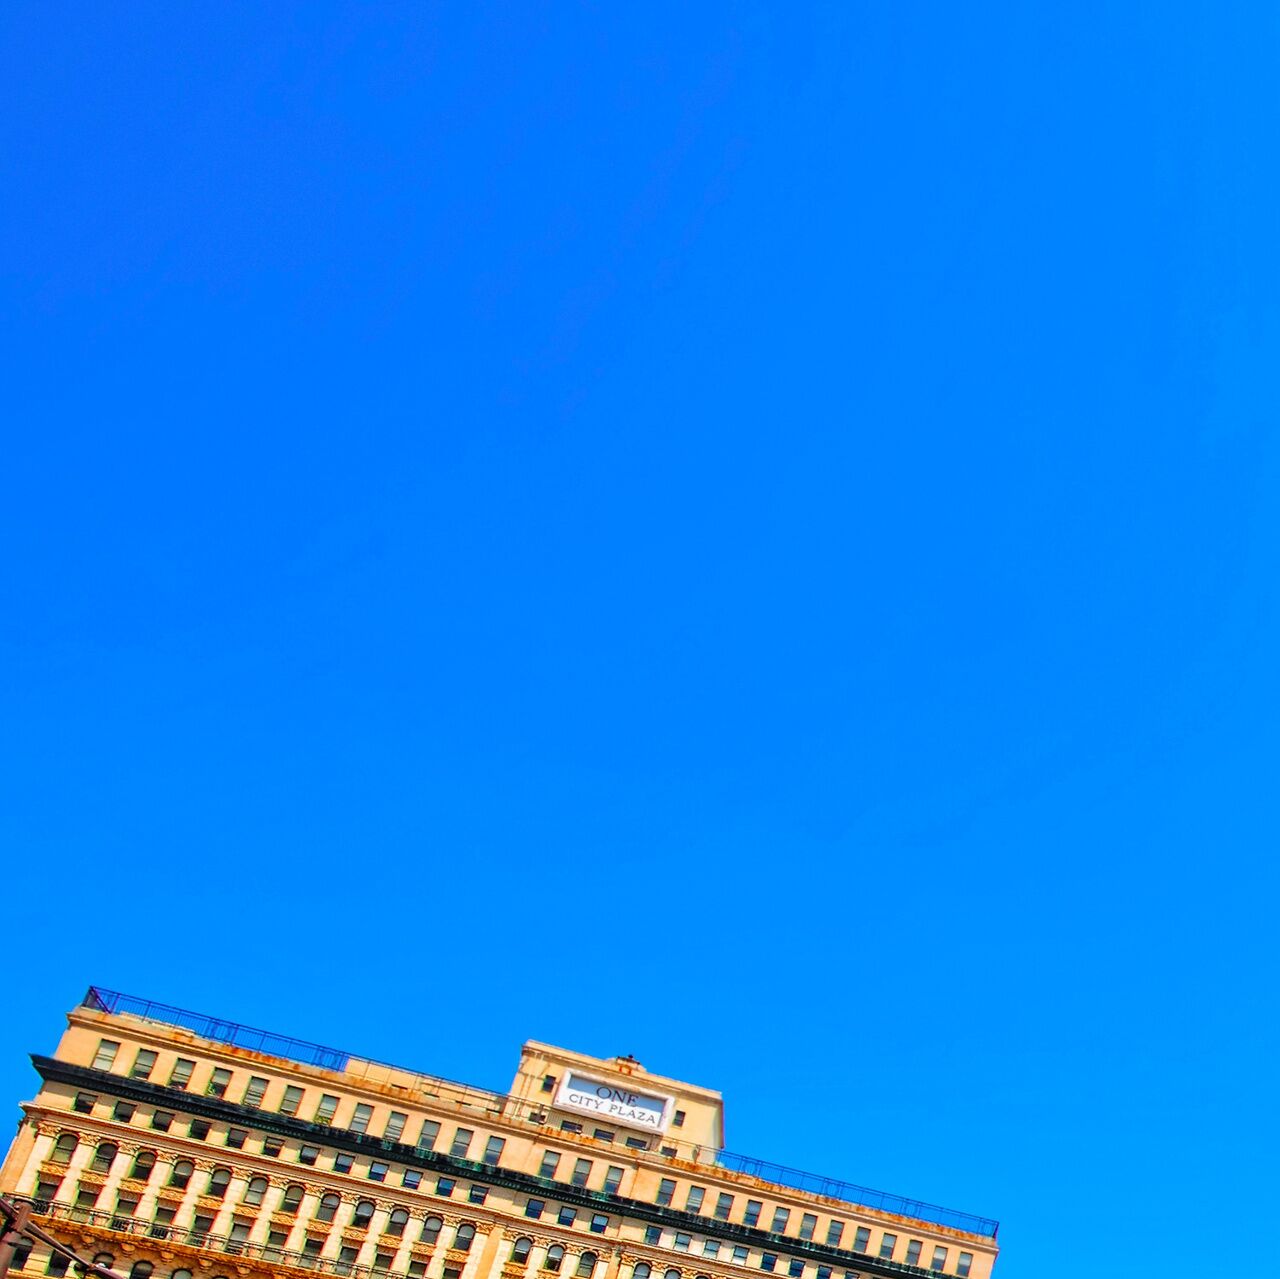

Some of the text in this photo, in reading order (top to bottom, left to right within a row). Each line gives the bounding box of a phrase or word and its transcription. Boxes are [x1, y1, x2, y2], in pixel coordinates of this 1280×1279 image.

[568, 1093, 656, 1124] CITY PLAZA
[596, 1086, 640, 1108] ONE
